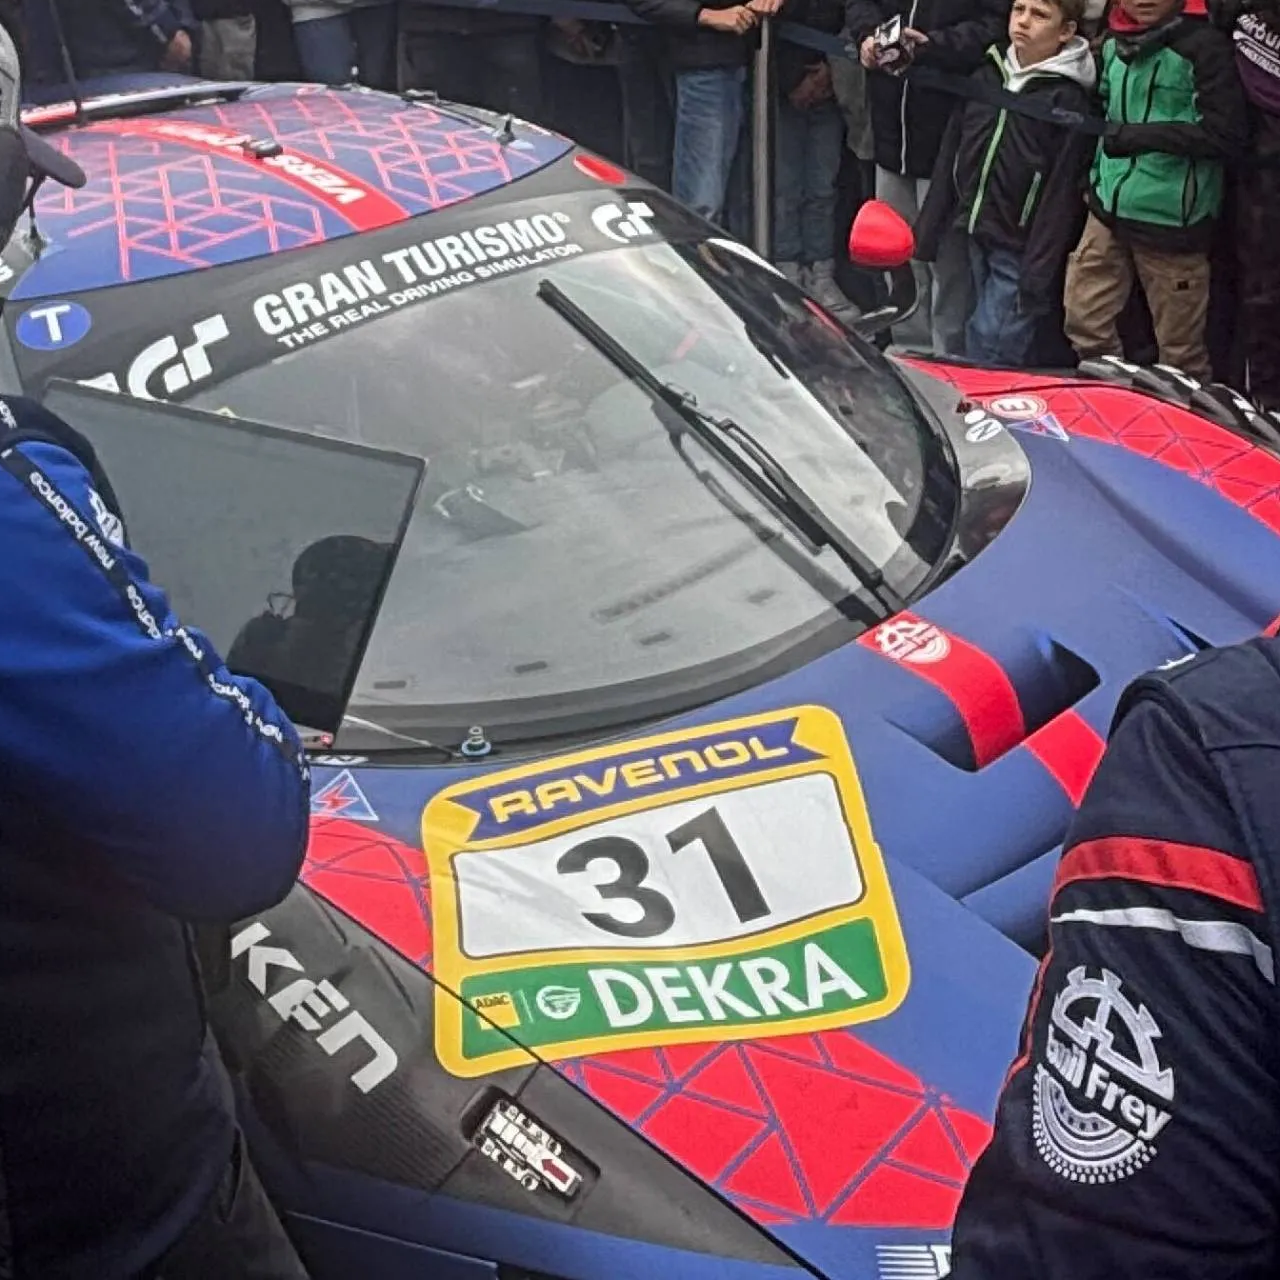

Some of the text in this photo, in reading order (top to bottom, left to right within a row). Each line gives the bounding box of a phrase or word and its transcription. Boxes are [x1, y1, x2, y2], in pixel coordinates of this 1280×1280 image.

[29, 304, 72, 343] T
[253, 260, 387, 337] GRAN
[276, 243, 584, 350] THE REAL DRIVING SIMULATOR
[488, 735, 790, 824] RAVENOL
[556, 805, 772, 939] 31
[475, 994, 510, 1009] ADAC
[587, 942, 868, 1029] DEKRA
[1084, 1062, 1173, 1140] Frey
